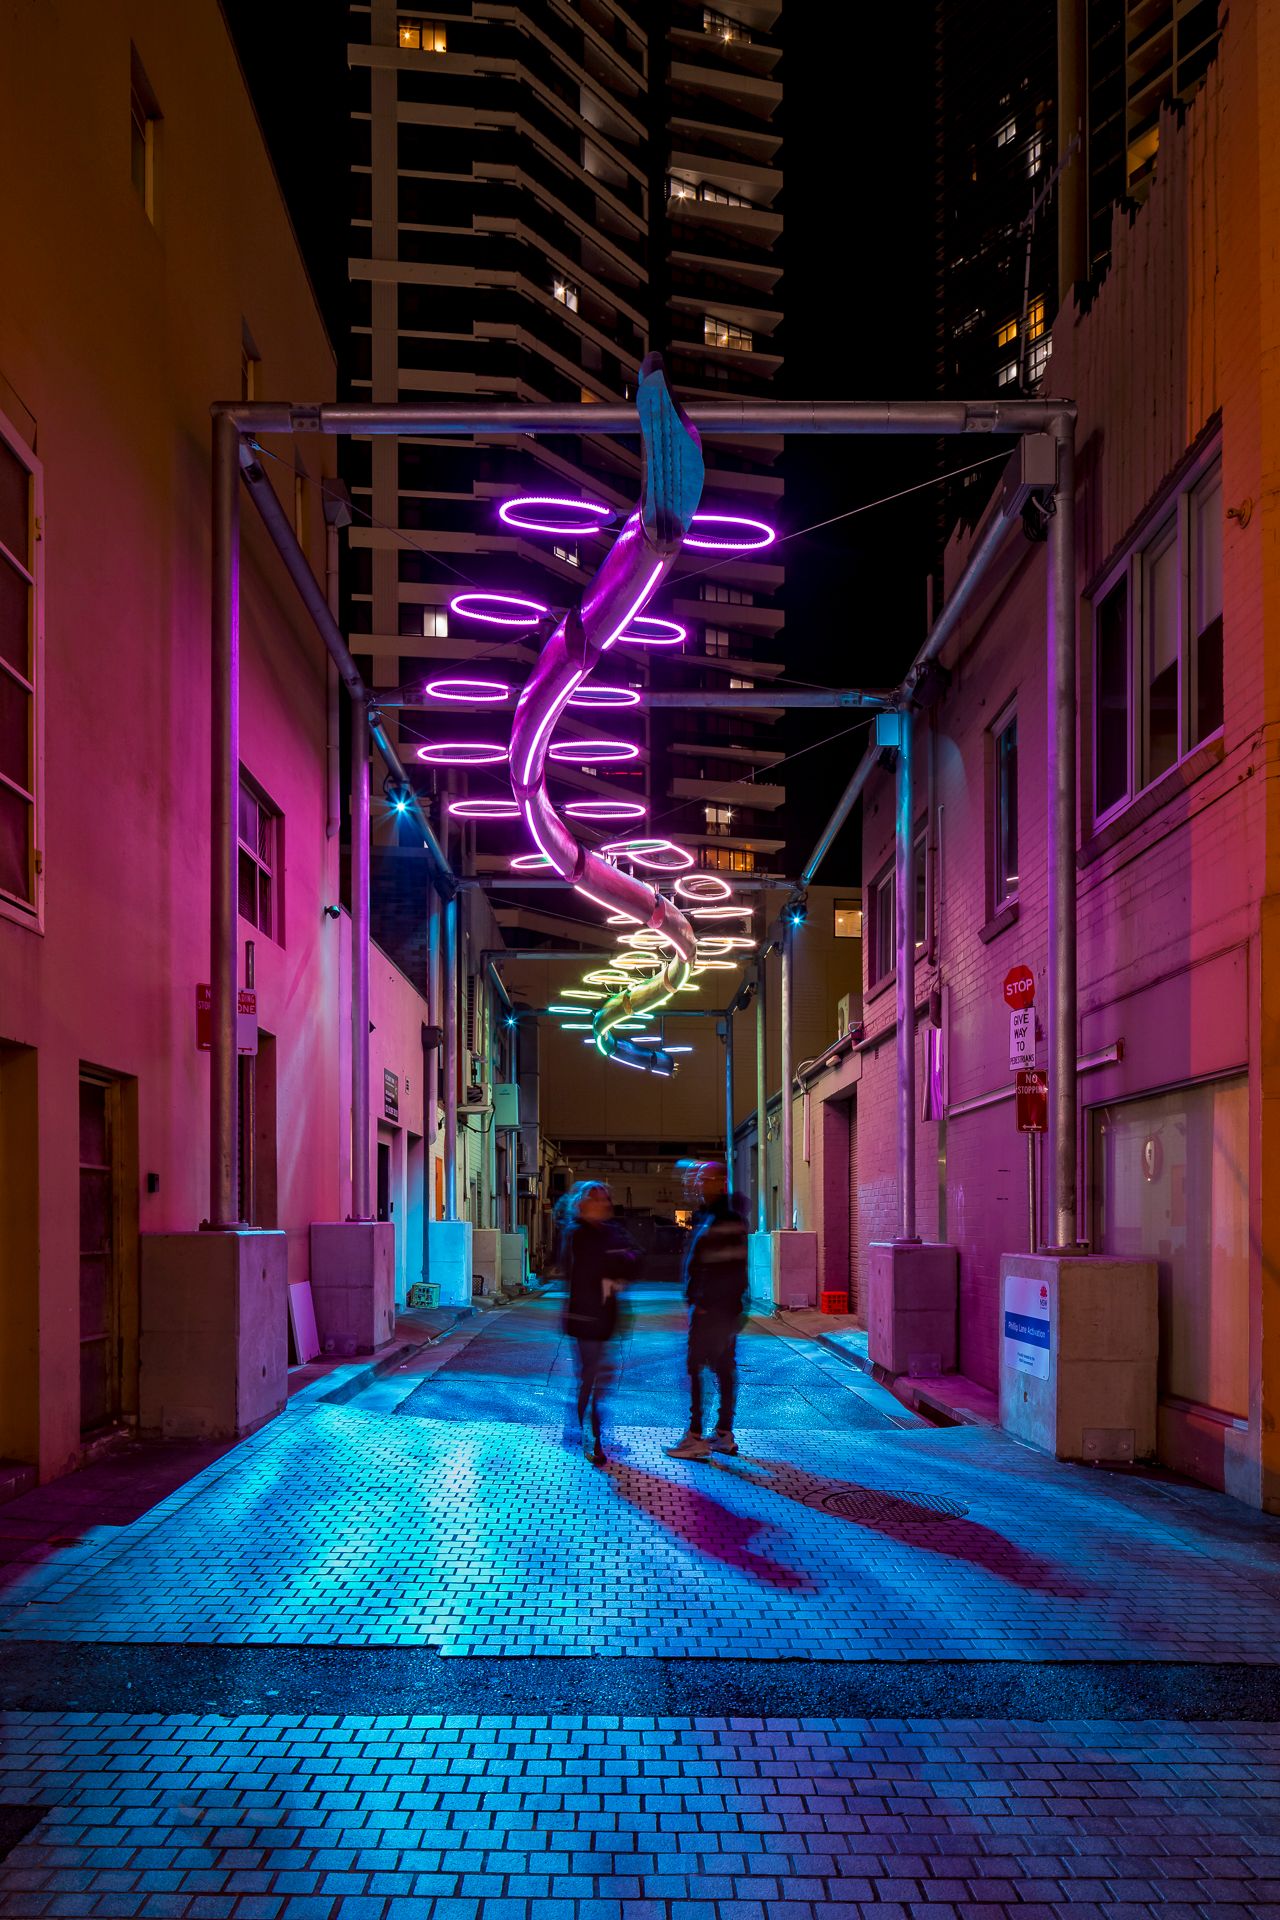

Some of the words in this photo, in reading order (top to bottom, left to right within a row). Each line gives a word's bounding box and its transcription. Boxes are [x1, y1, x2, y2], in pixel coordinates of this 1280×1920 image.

[1006, 978, 1033, 996] STOP
[238, 1004, 256, 1014] ONE
[1014, 1013, 1029, 1026] GIVE
[1014, 1027, 1028, 1039] WAY
[1016, 1041, 1025, 1051] TO
[1010, 1054, 1034, 1065] PEDESTRIANS
[1025, 1073, 1038, 1084] NO
[1018, 1323, 1028, 1334] Lane
[1027, 1326, 1046, 1338] Activation
